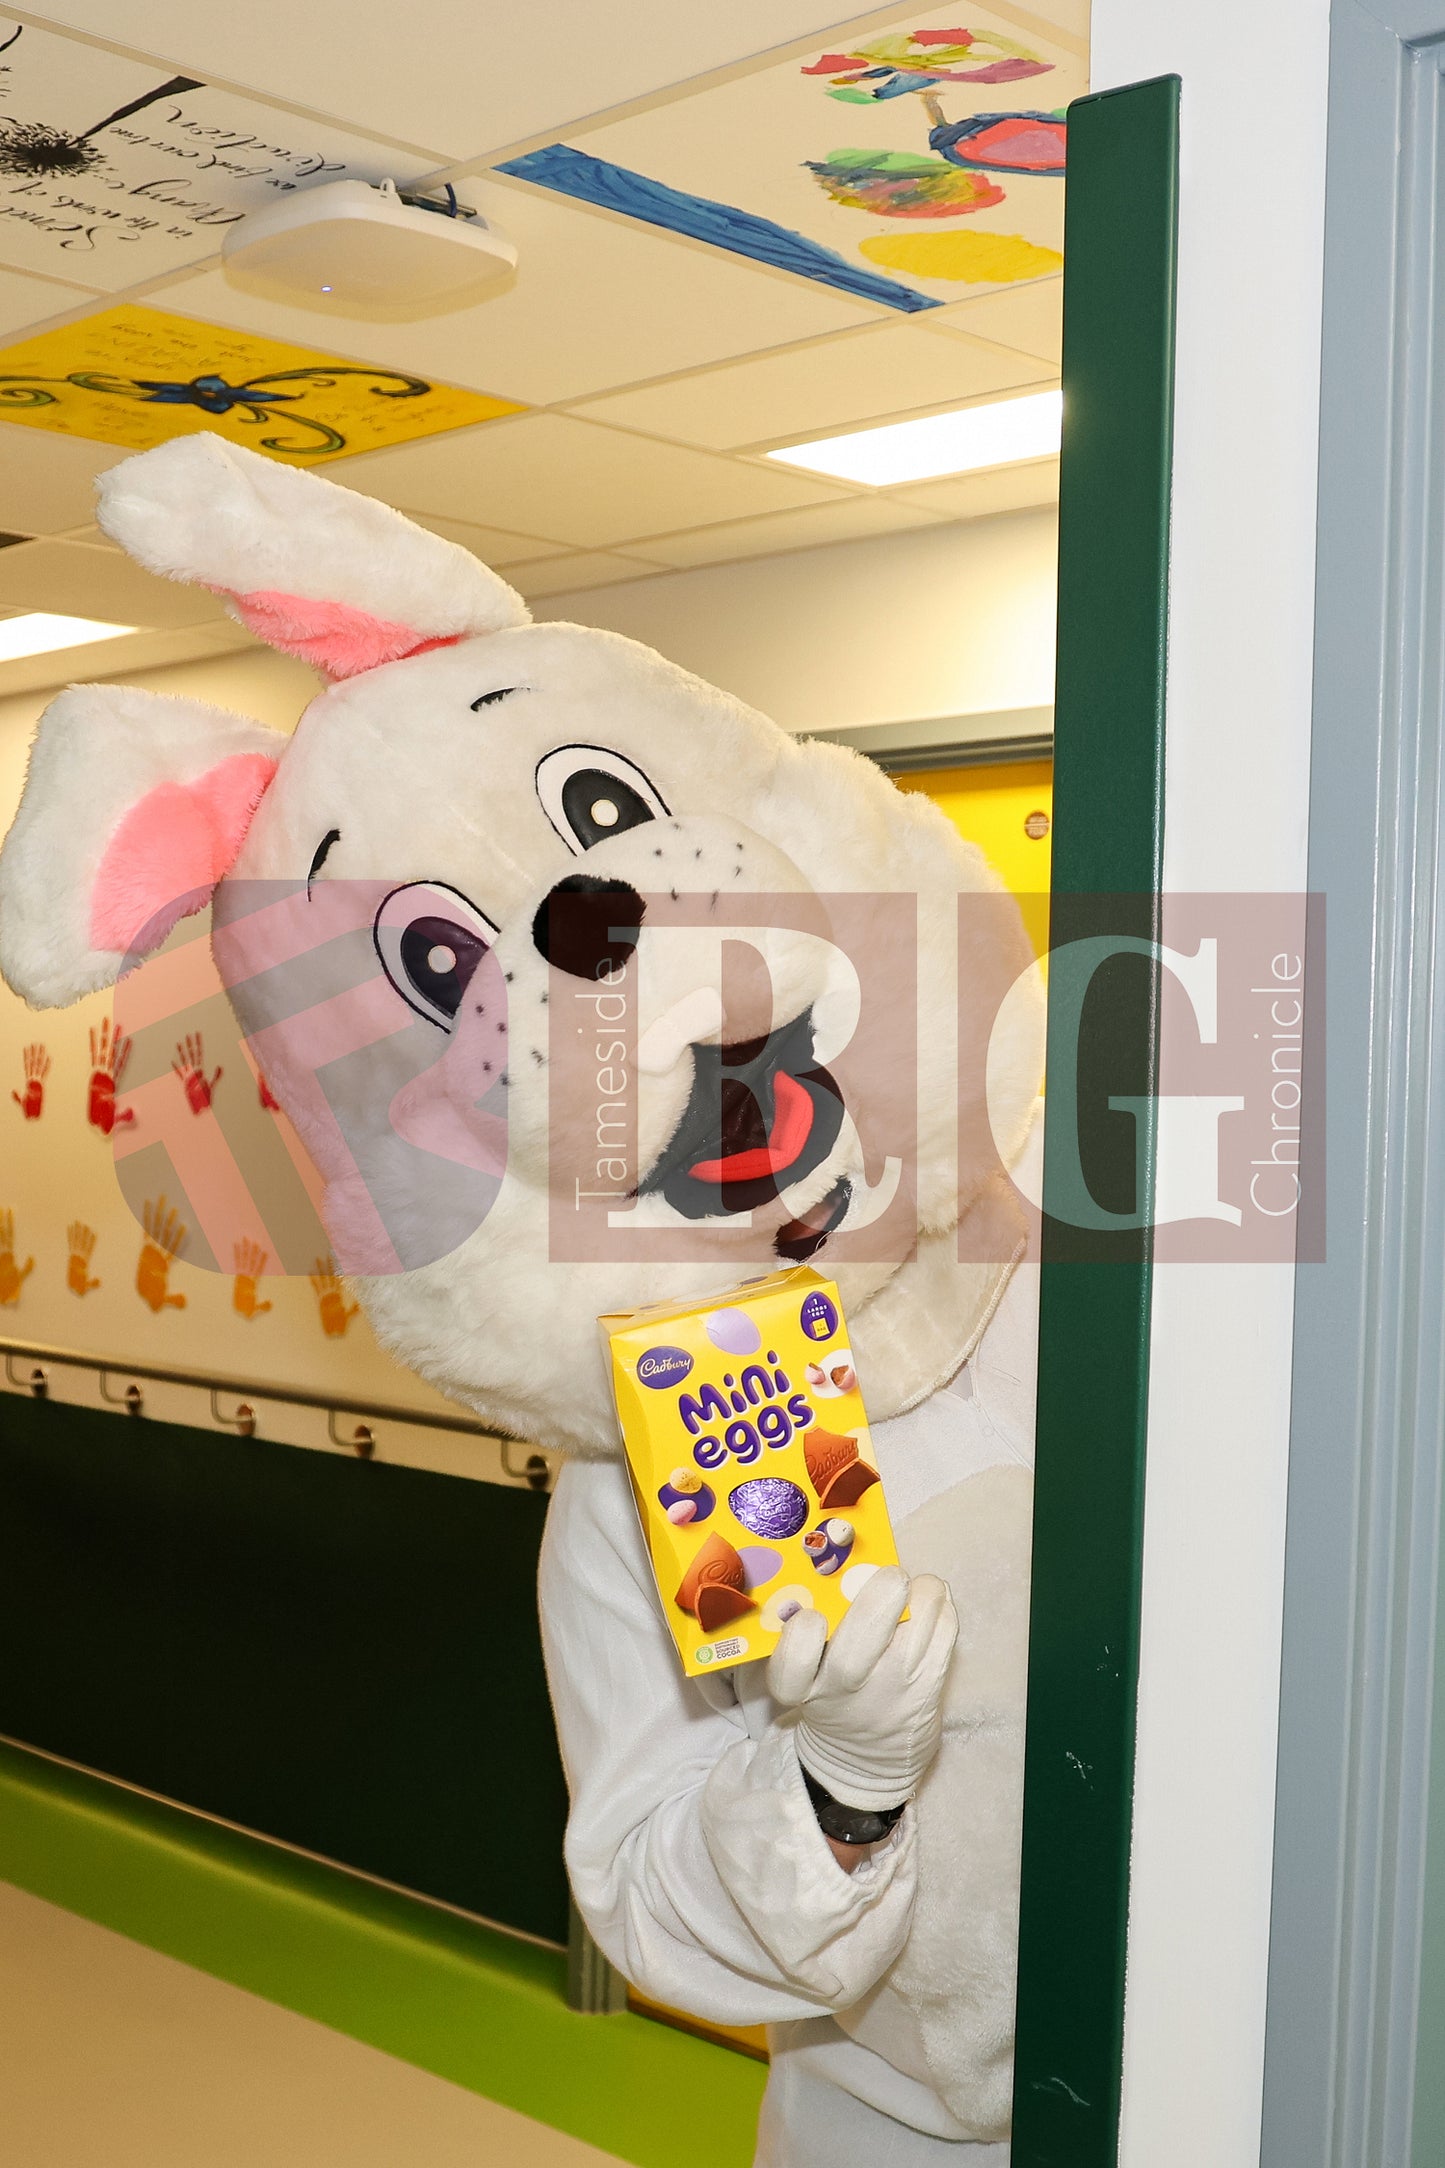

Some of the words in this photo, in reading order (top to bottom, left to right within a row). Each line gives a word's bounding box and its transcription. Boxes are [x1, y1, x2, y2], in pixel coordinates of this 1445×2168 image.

[640, 1357, 692, 1378] Cadbury
[678, 1349, 791, 1436] Mini
[692, 1393, 814, 1469] eggs
[716, 1648, 742, 1659] COCOA
